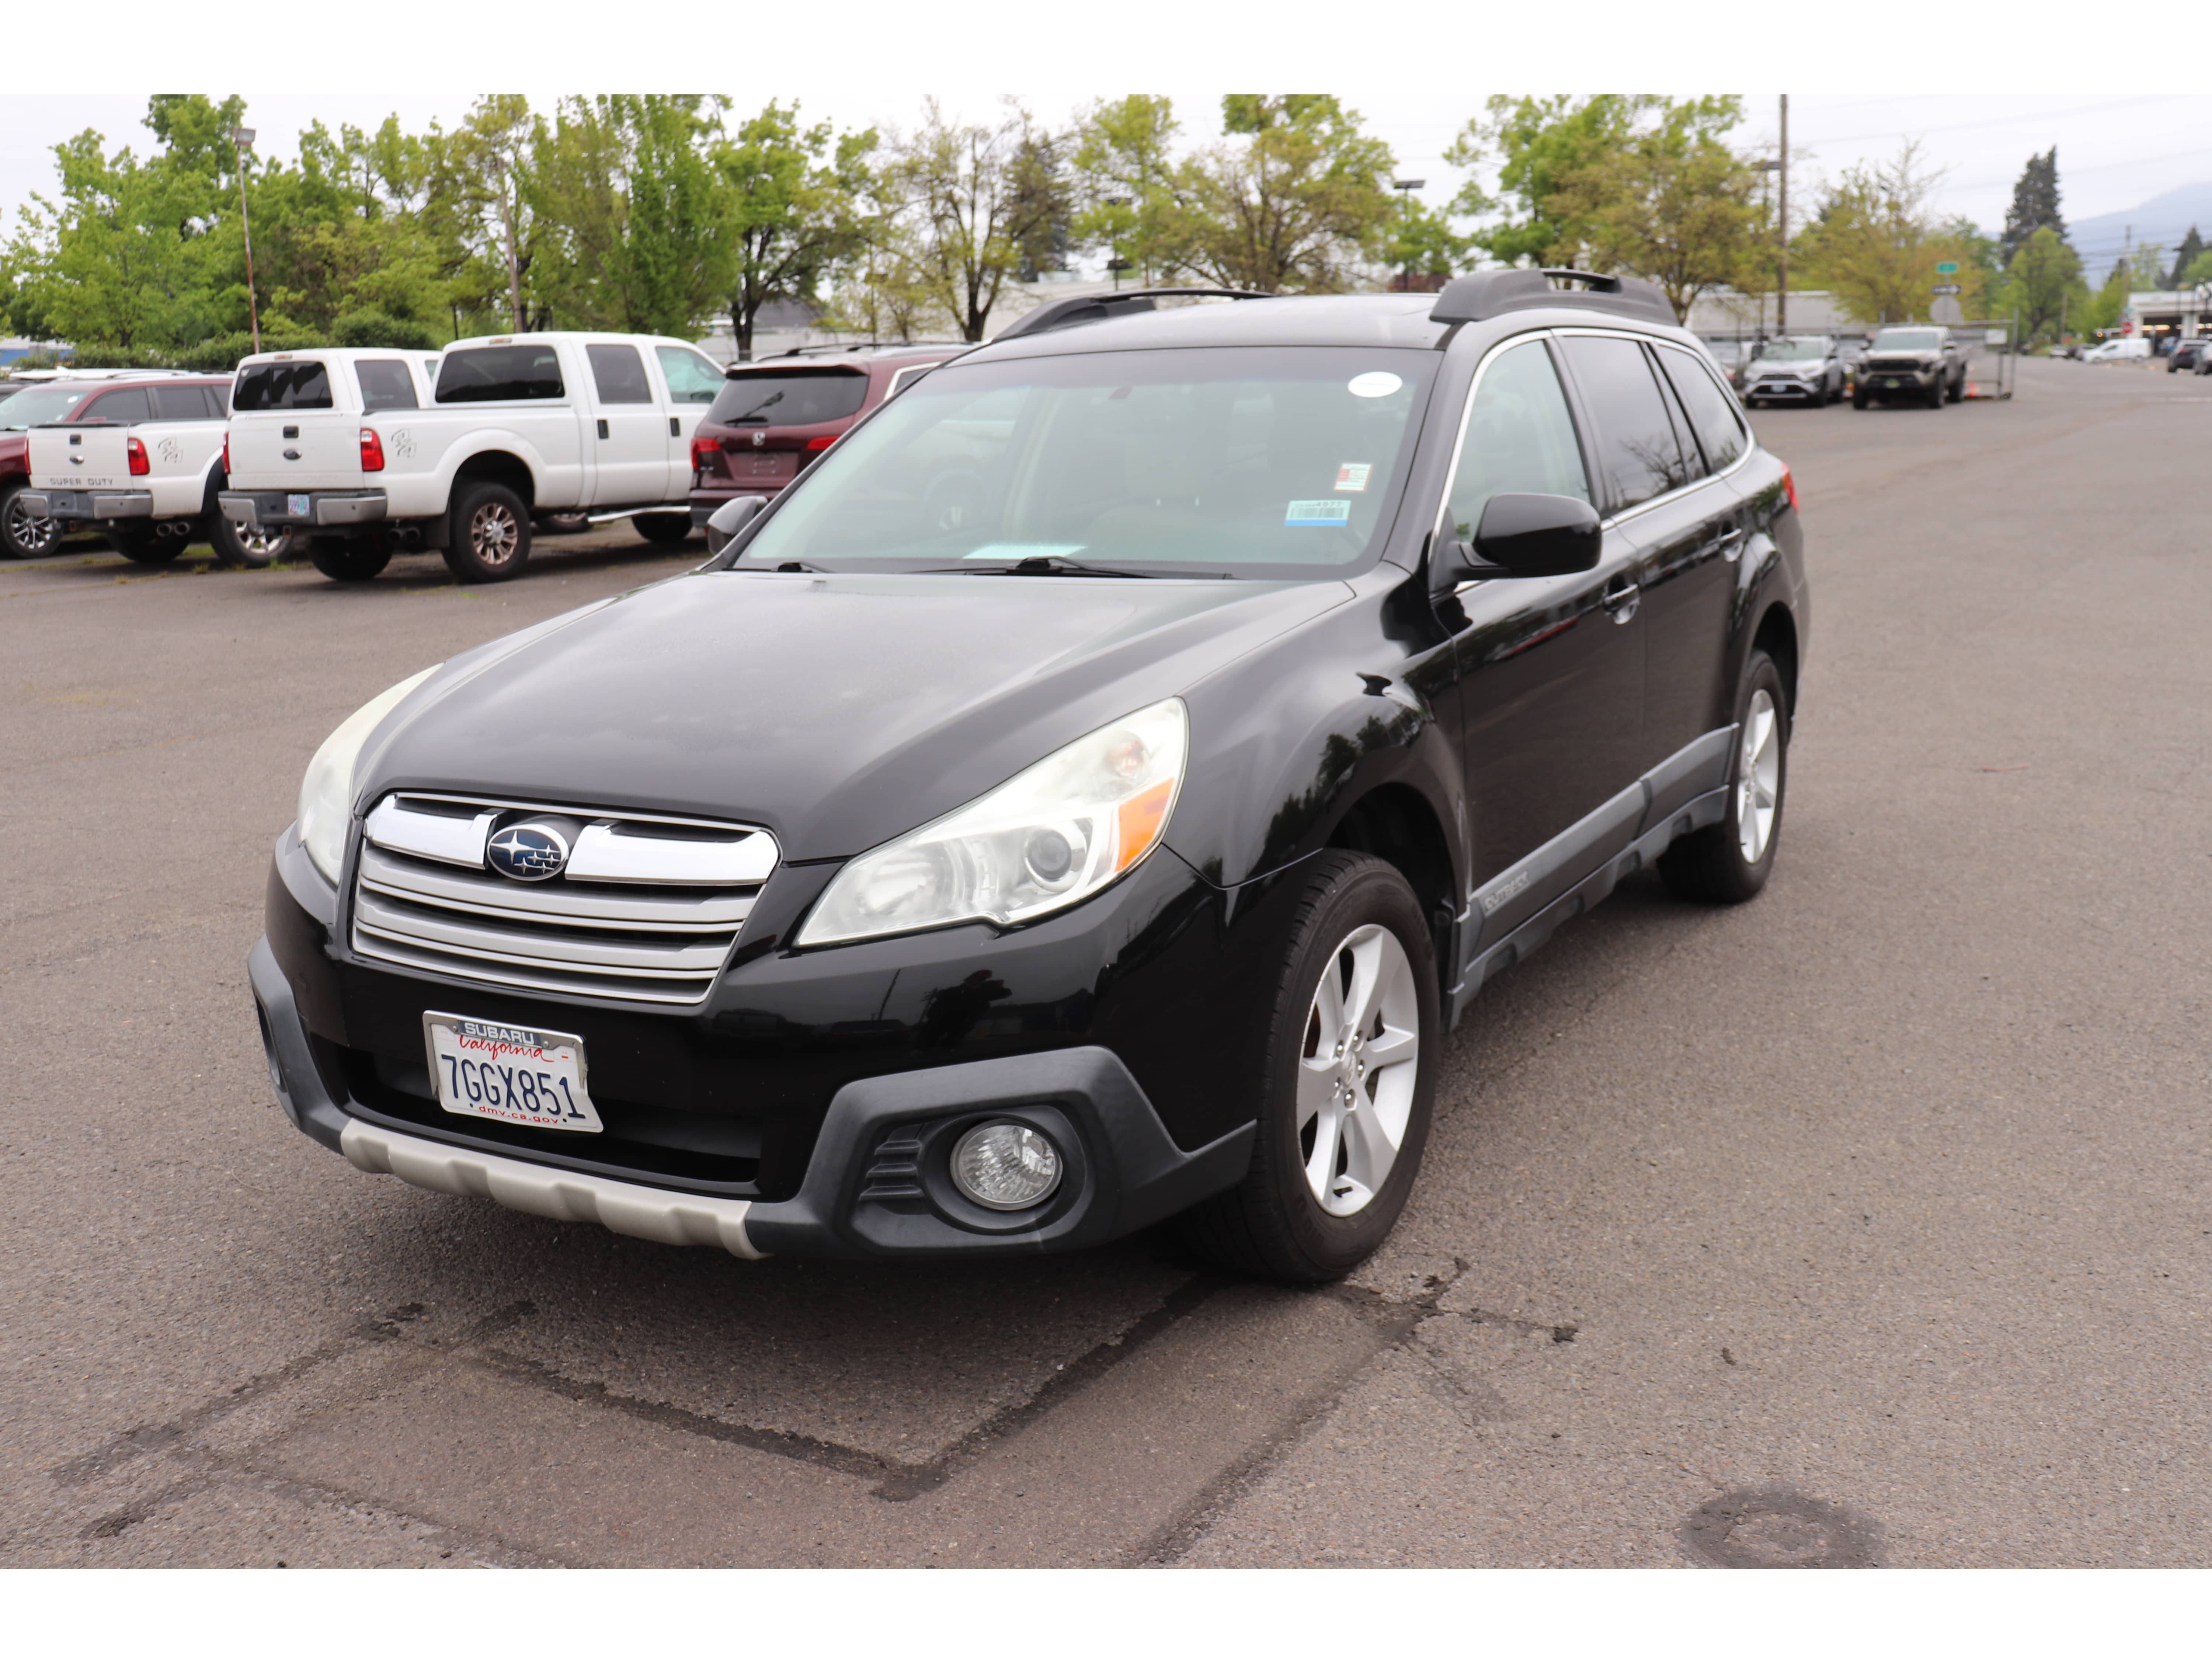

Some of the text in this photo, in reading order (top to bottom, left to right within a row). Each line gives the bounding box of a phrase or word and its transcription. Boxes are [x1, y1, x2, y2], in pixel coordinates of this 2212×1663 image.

[50, 477, 82, 486] SUPER
[464, 1022, 534, 1044] SUBARU
[460, 1034, 555, 1062] California
[441, 1054, 586, 1119] 7GGX851
[479, 1106, 559, 1124] dmv.ca.gov
